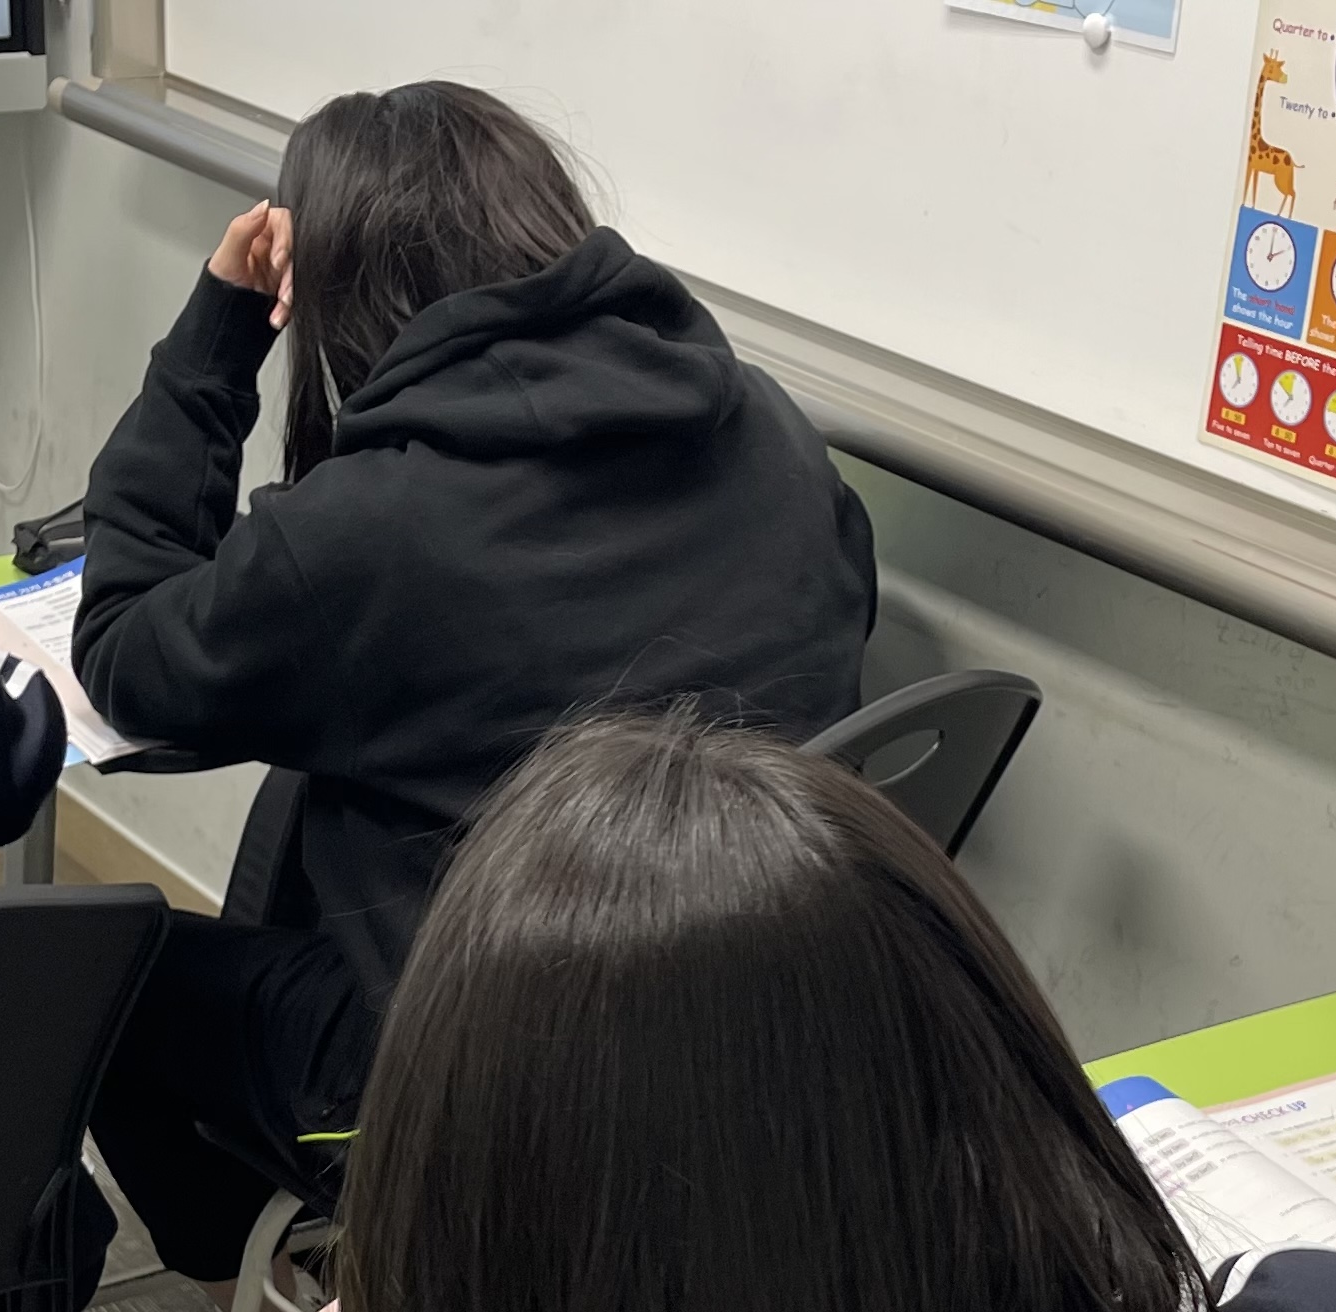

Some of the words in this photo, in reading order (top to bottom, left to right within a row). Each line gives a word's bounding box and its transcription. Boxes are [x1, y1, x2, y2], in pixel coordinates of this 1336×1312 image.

[1273, 19, 1314, 38] Quarter
[1317, 30, 1327, 41] to
[1280, 96, 1315, 119] Twenty
[1318, 109, 1328, 119] to
